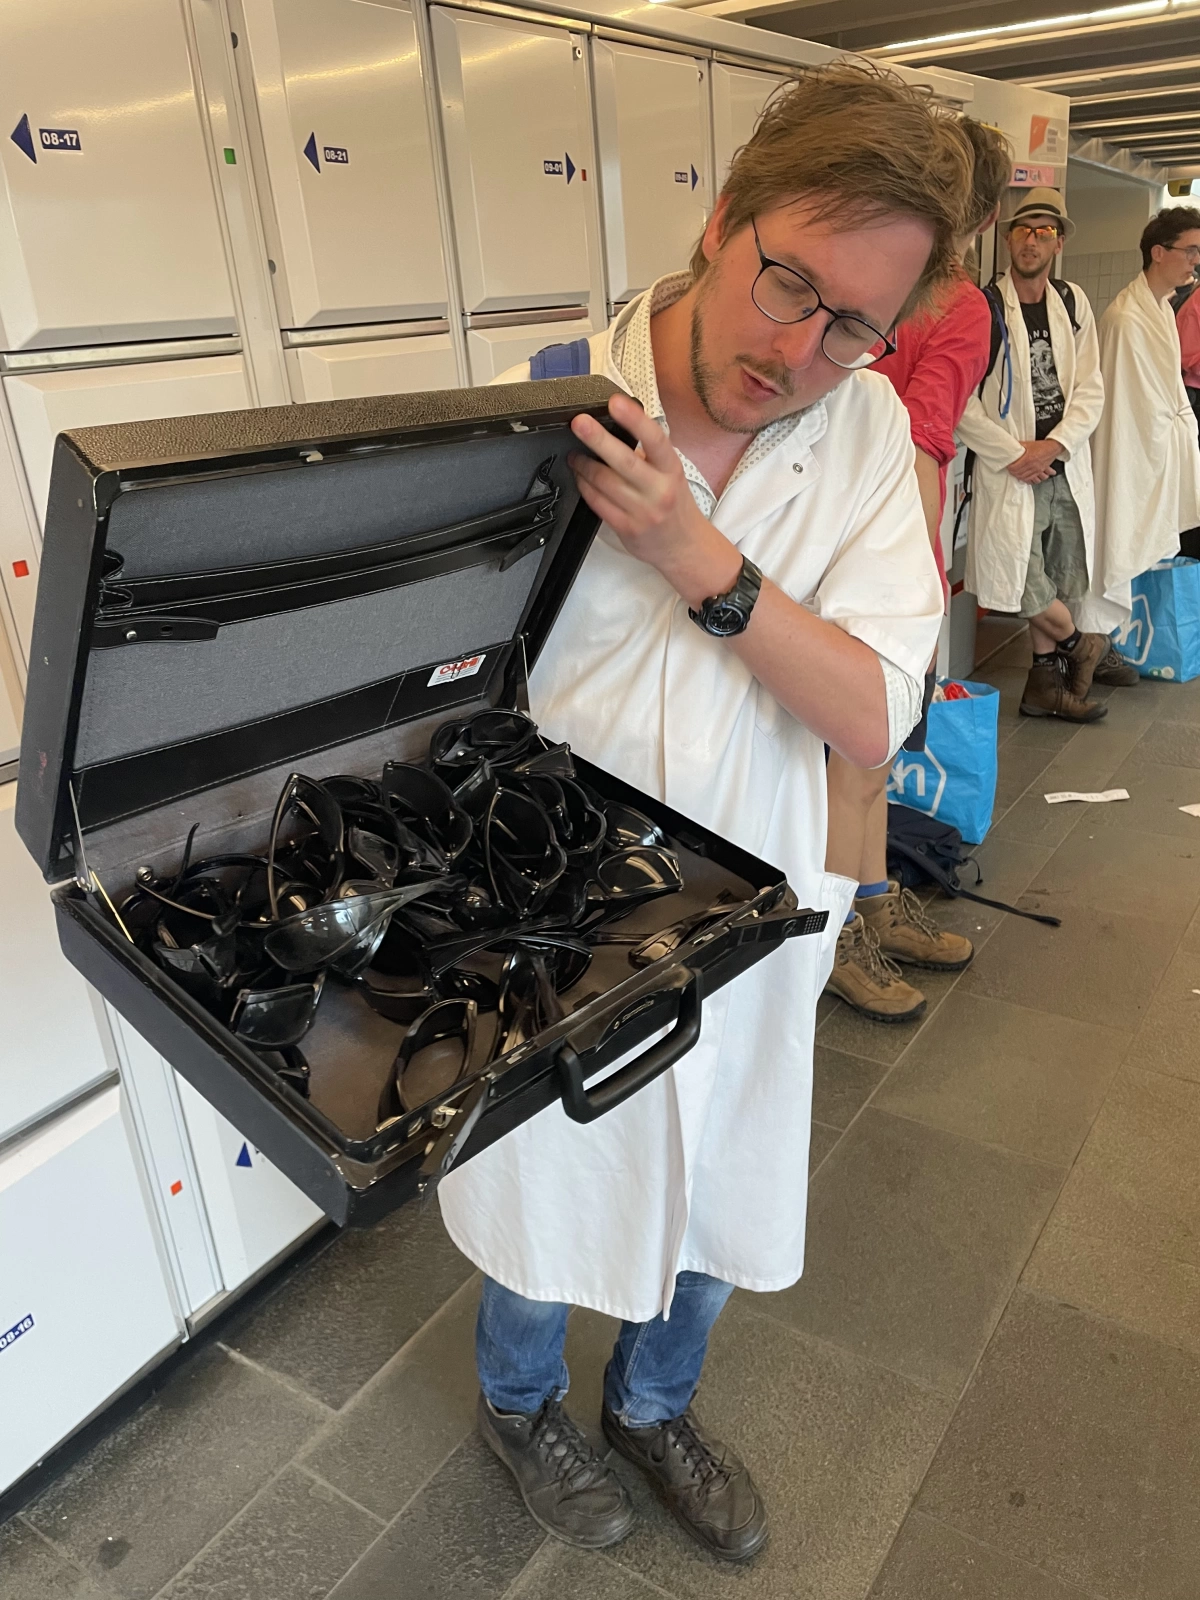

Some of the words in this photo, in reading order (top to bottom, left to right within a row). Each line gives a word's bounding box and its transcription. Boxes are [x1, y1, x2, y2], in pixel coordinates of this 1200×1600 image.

[41, 132, 78, 146] 08-17
[325, 149, 347, 161] 08-21
[0, 1317, 33, 1349] 08-16
